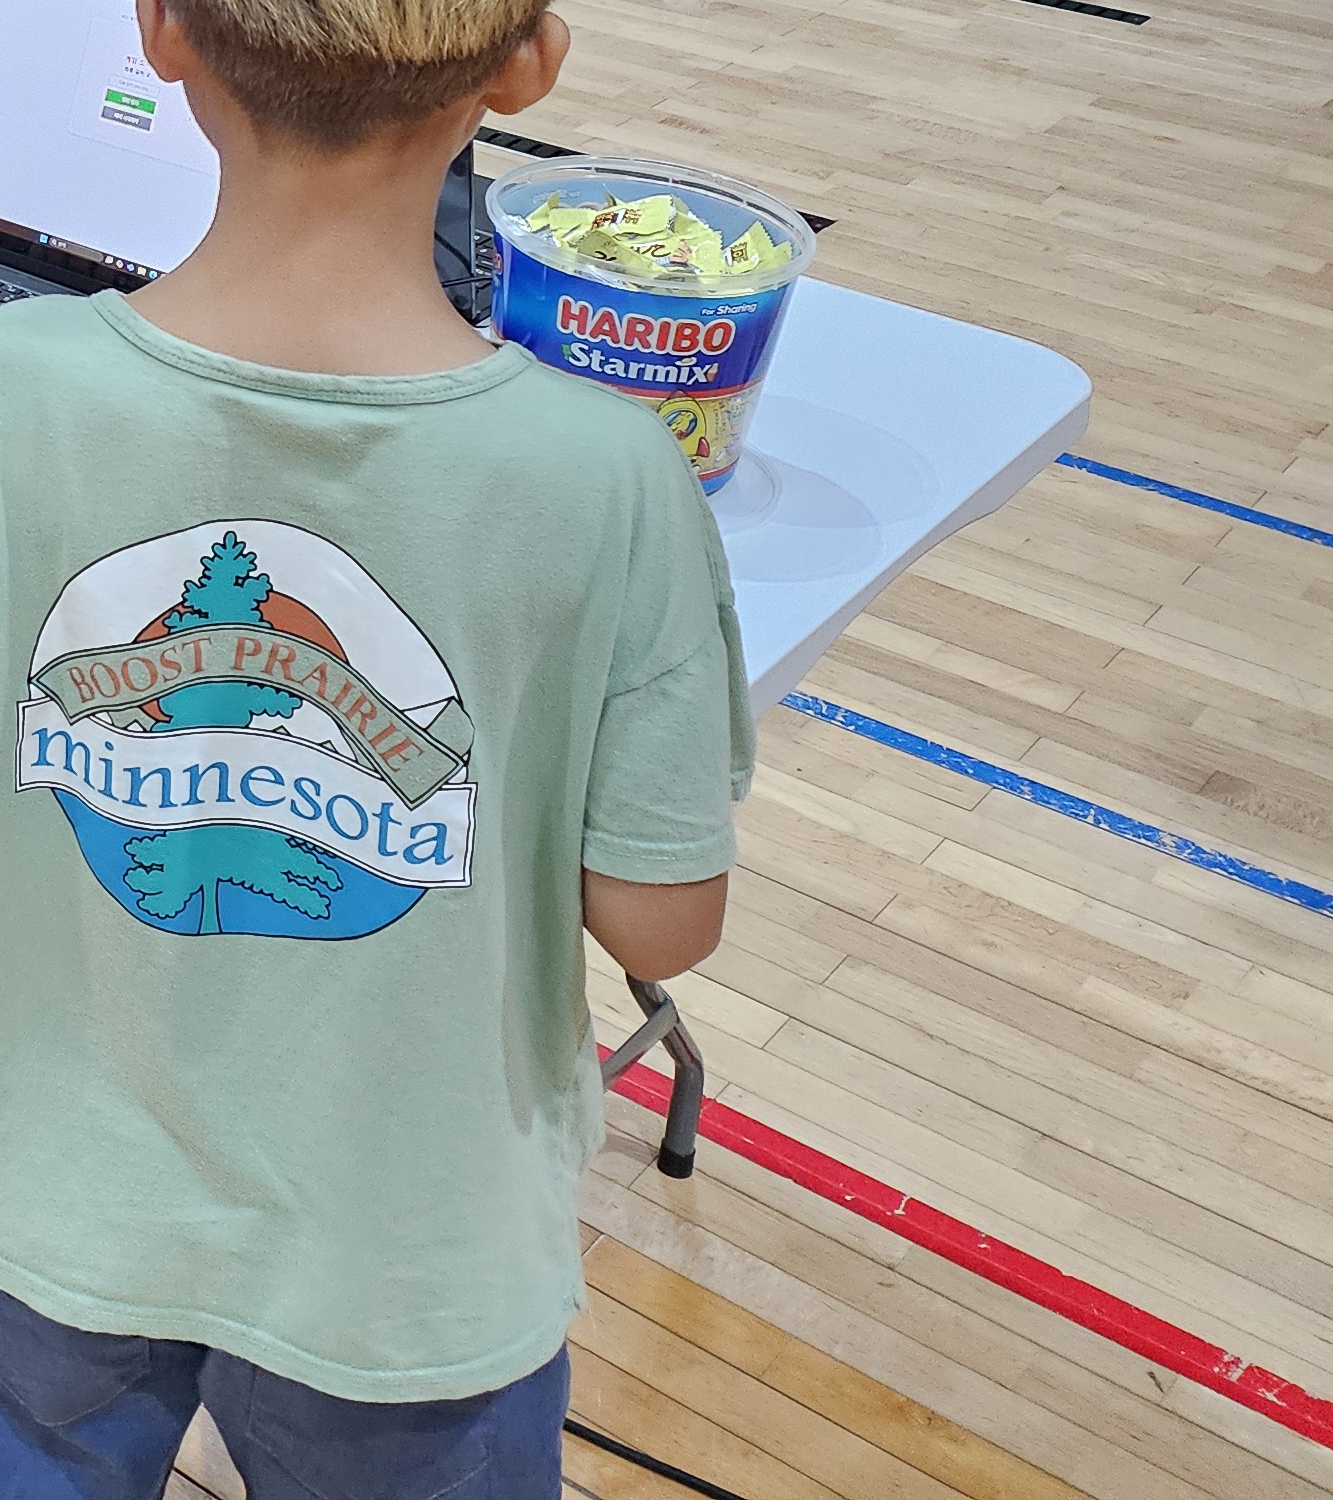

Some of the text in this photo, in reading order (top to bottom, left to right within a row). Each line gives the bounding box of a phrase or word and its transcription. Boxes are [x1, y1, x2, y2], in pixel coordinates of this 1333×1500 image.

[559, 297, 734, 354] HARIBO
[716, 303, 758, 315] Sharing
[568, 340, 713, 386] Starmix
[68, 635, 426, 774] BOOST PRAIRIE
[30, 726, 455, 867] minnesota
